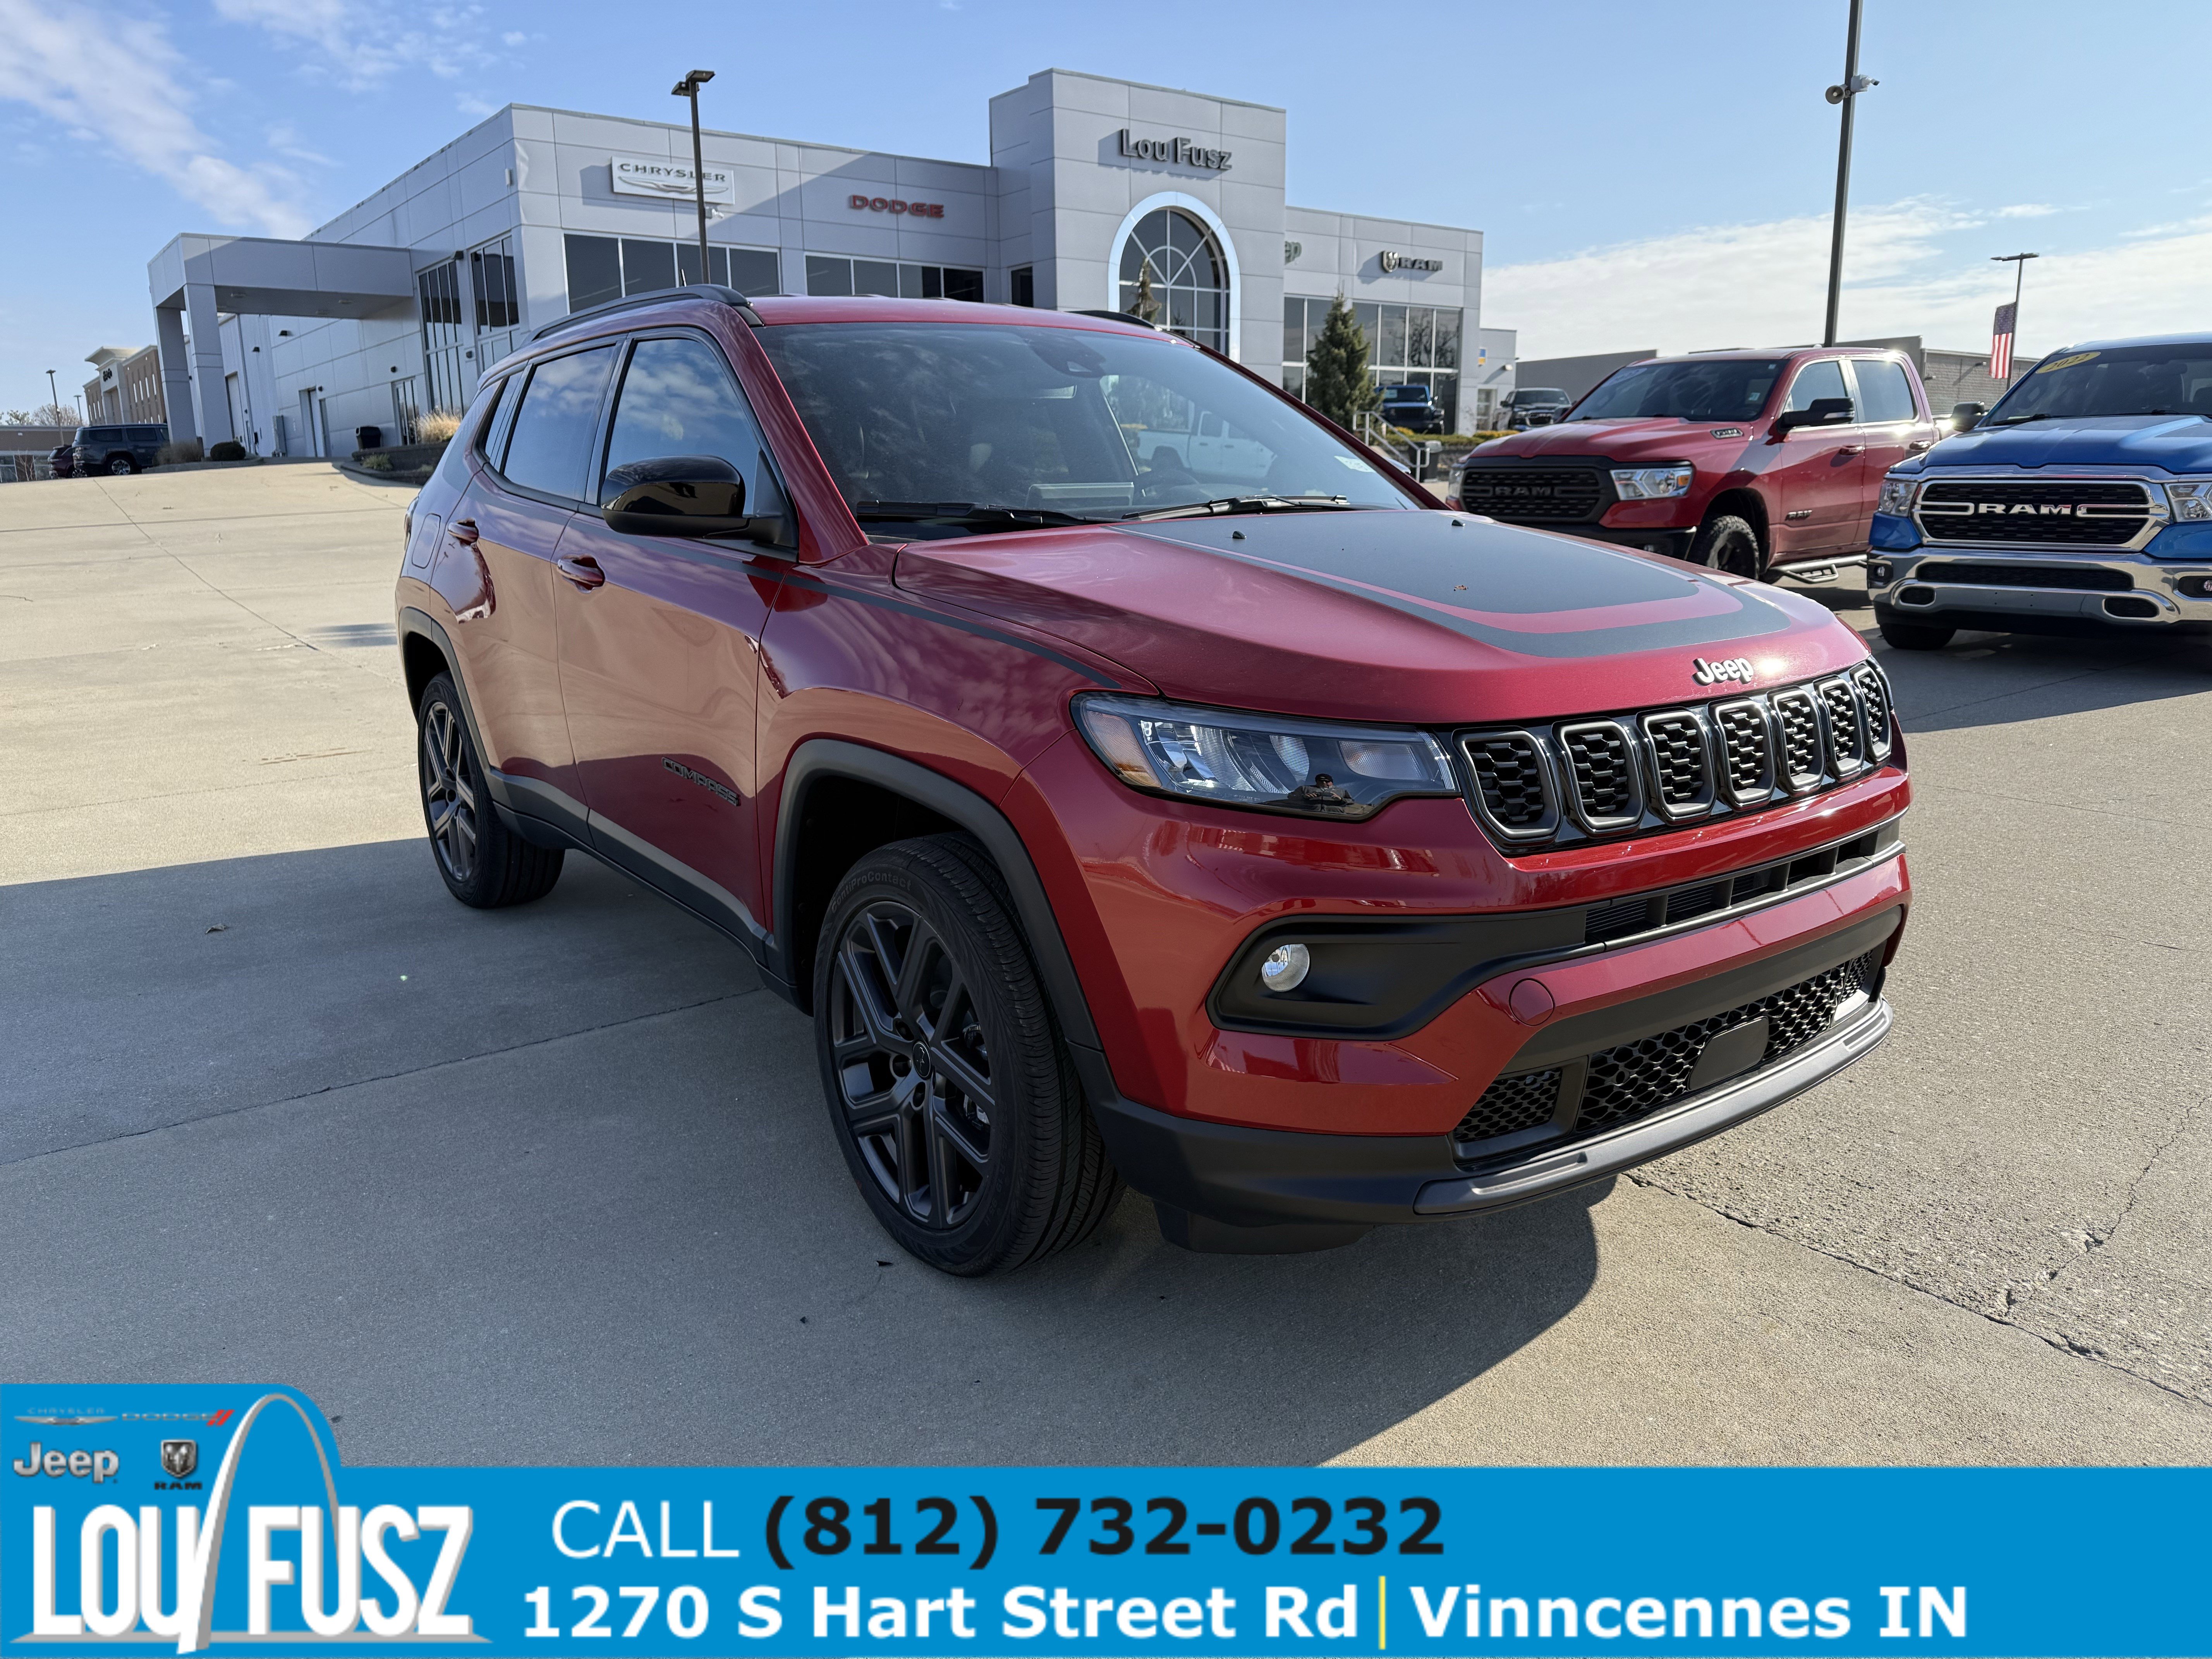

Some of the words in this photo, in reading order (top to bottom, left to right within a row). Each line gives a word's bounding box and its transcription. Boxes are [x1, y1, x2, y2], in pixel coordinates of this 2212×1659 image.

[1121, 129, 1170, 161] Lou
[1176, 137, 1232, 170] Fusz
[620, 163, 726, 182] CHRYSLER
[850, 194, 945, 218] DODGE
[1398, 257, 1443, 271] RAM
[2045, 353, 2090, 371] 2022
[1495, 486, 1551, 496] RAM
[1978, 503, 2071, 515] RAM
[1692, 658, 1754, 686] Jeep
[661, 757, 739, 807] COMPASS
[831, 871, 912, 914] ContiProContact
